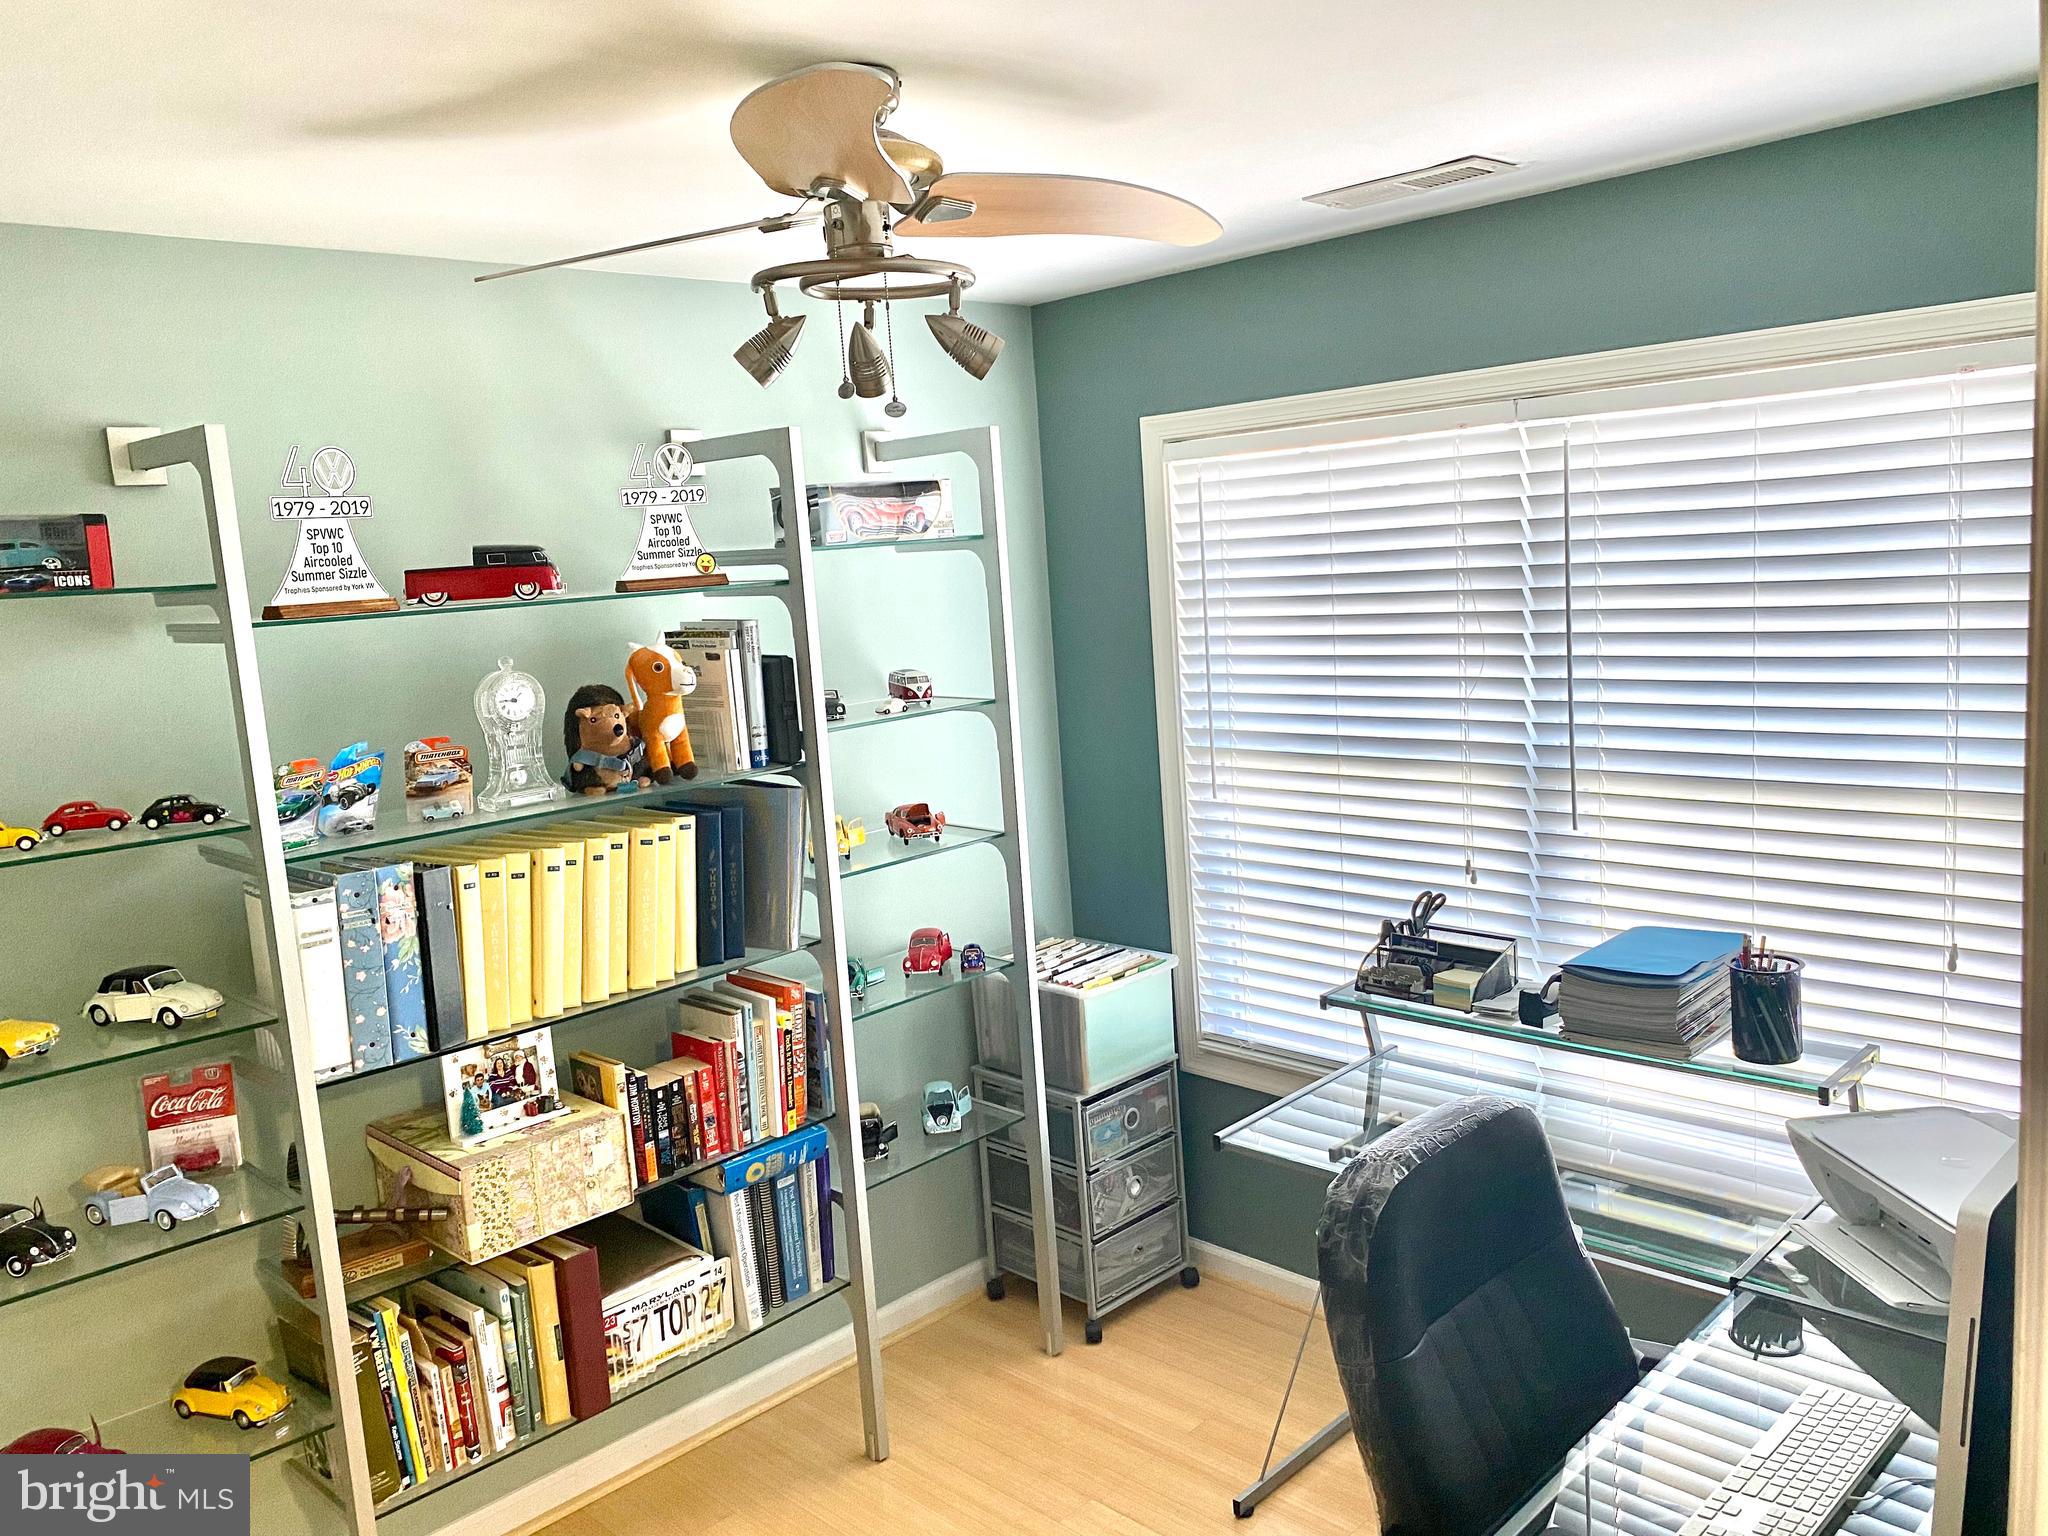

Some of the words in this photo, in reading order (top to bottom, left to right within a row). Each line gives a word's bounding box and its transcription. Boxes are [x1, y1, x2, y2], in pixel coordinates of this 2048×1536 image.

[623, 491, 658, 505] 1979
[671, 489, 705, 503] 2019
[274, 501, 315, 517] 1979
[330, 500, 369, 515] 2019
[650, 513, 683, 524] SPVWC
[306, 528, 344, 540] SPVWC
[654, 527, 670, 537] Top
[672, 525, 682, 535] 10
[311, 543, 329, 556] Top
[332, 542, 343, 553] 10
[648, 536, 690, 548] Aircooled
[637, 550, 675, 560] Summer
[678, 548, 703, 557] Sizzle
[304, 555, 353, 568] Aircooled
[53, 575, 91, 587] ICONS
[291, 571, 336, 582] Summer
[339, 567, 368, 579] Sizzle
[285, 587, 310, 595] Trophies
[311, 585, 343, 593] Sponsored
[344, 584, 351, 592] by
[419, 750, 461, 760] MATCHBOX
[794, 1004, 803, 1041] HOME
[628, 1084, 638, 1097] JIM
[630, 1097, 641, 1126] NORTON
[790, 1200, 799, 1240] Management
[795, 1241, 803, 1277] Technology
[736, 1209, 744, 1252] Management
[742, 1253, 750, 1288] Operations
[714, 1266, 722, 1276] 14
[632, 1279, 695, 1313] MARYLAND
[604, 1316, 616, 1328] 23
[653, 1293, 696, 1341] TOP
[370, 1328, 382, 1349] VW
[374, 1349, 390, 1391] BEETLE
[391, 1425, 399, 1440] Keith
[395, 1440, 403, 1461] Seume
